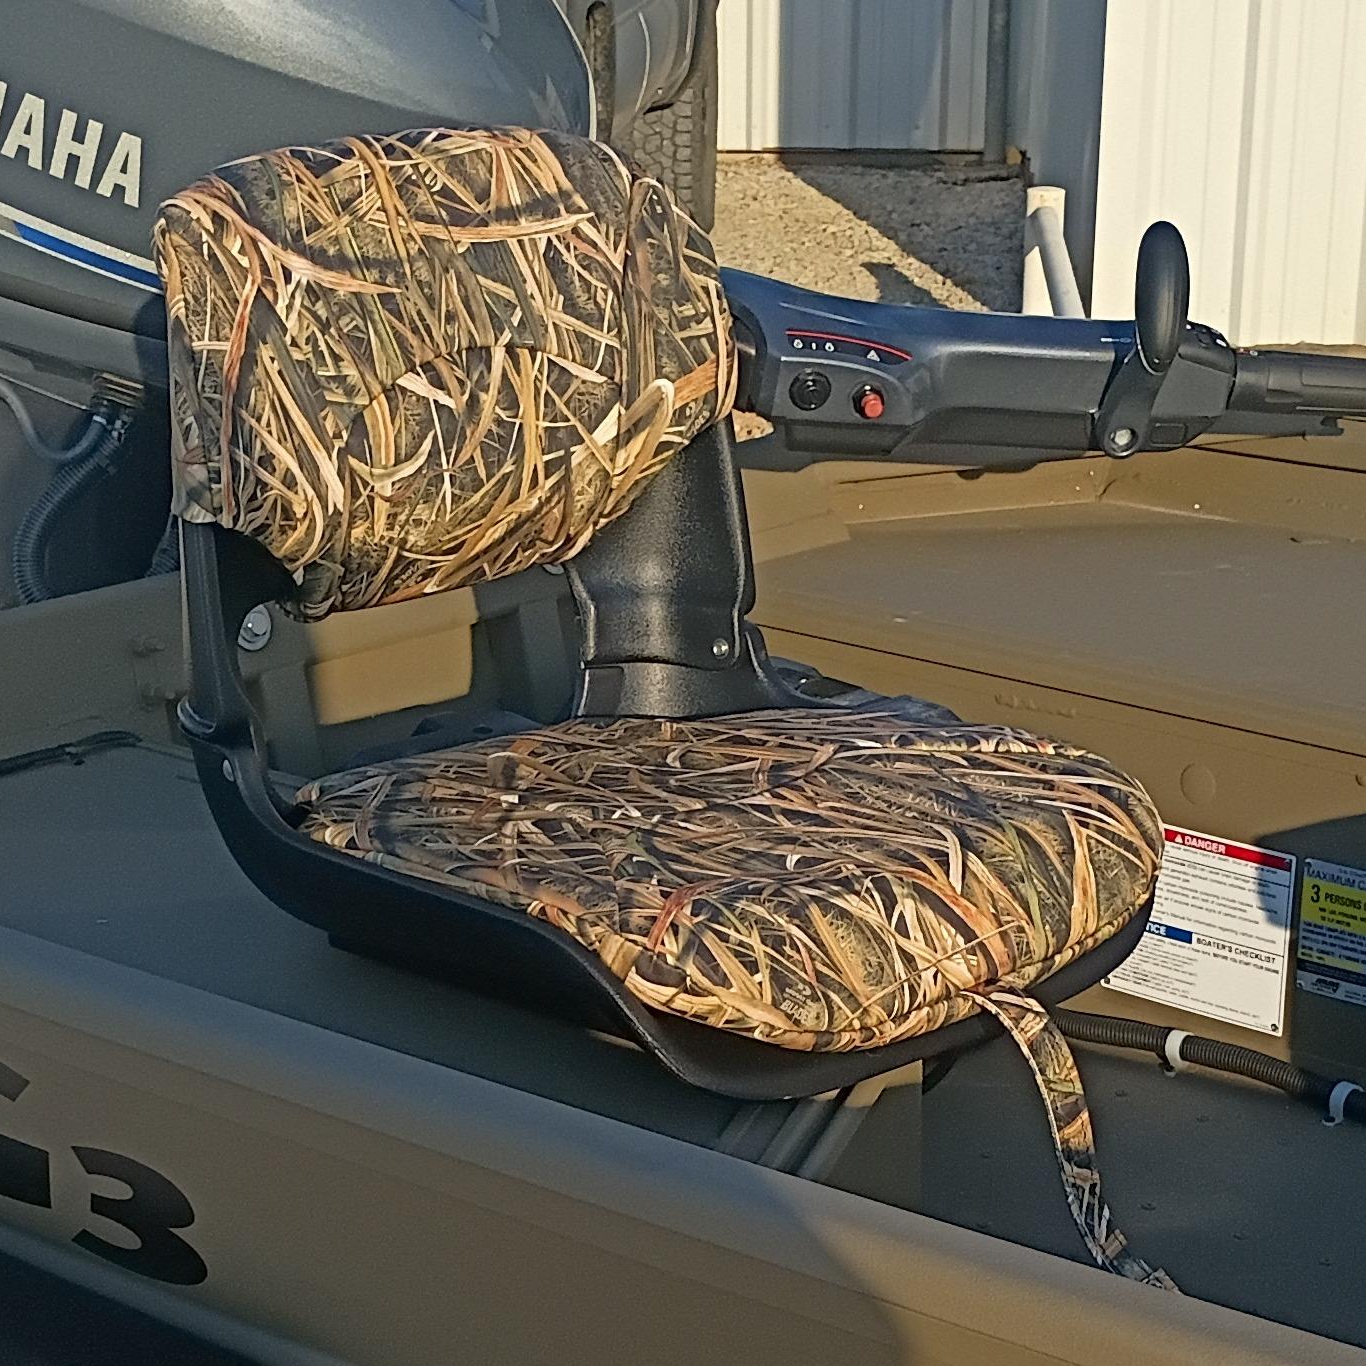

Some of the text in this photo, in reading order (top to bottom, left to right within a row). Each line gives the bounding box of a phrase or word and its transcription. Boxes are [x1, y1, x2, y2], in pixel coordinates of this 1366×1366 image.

[1184, 835, 1227, 855] DANGER
[1306, 868, 1356, 889] MAXIMUM
[1310, 884, 1321, 904] 3
[1325, 892, 1362, 911] PERSONS
[1196, 937, 1276, 964] BOATER'S CHECKLIST
